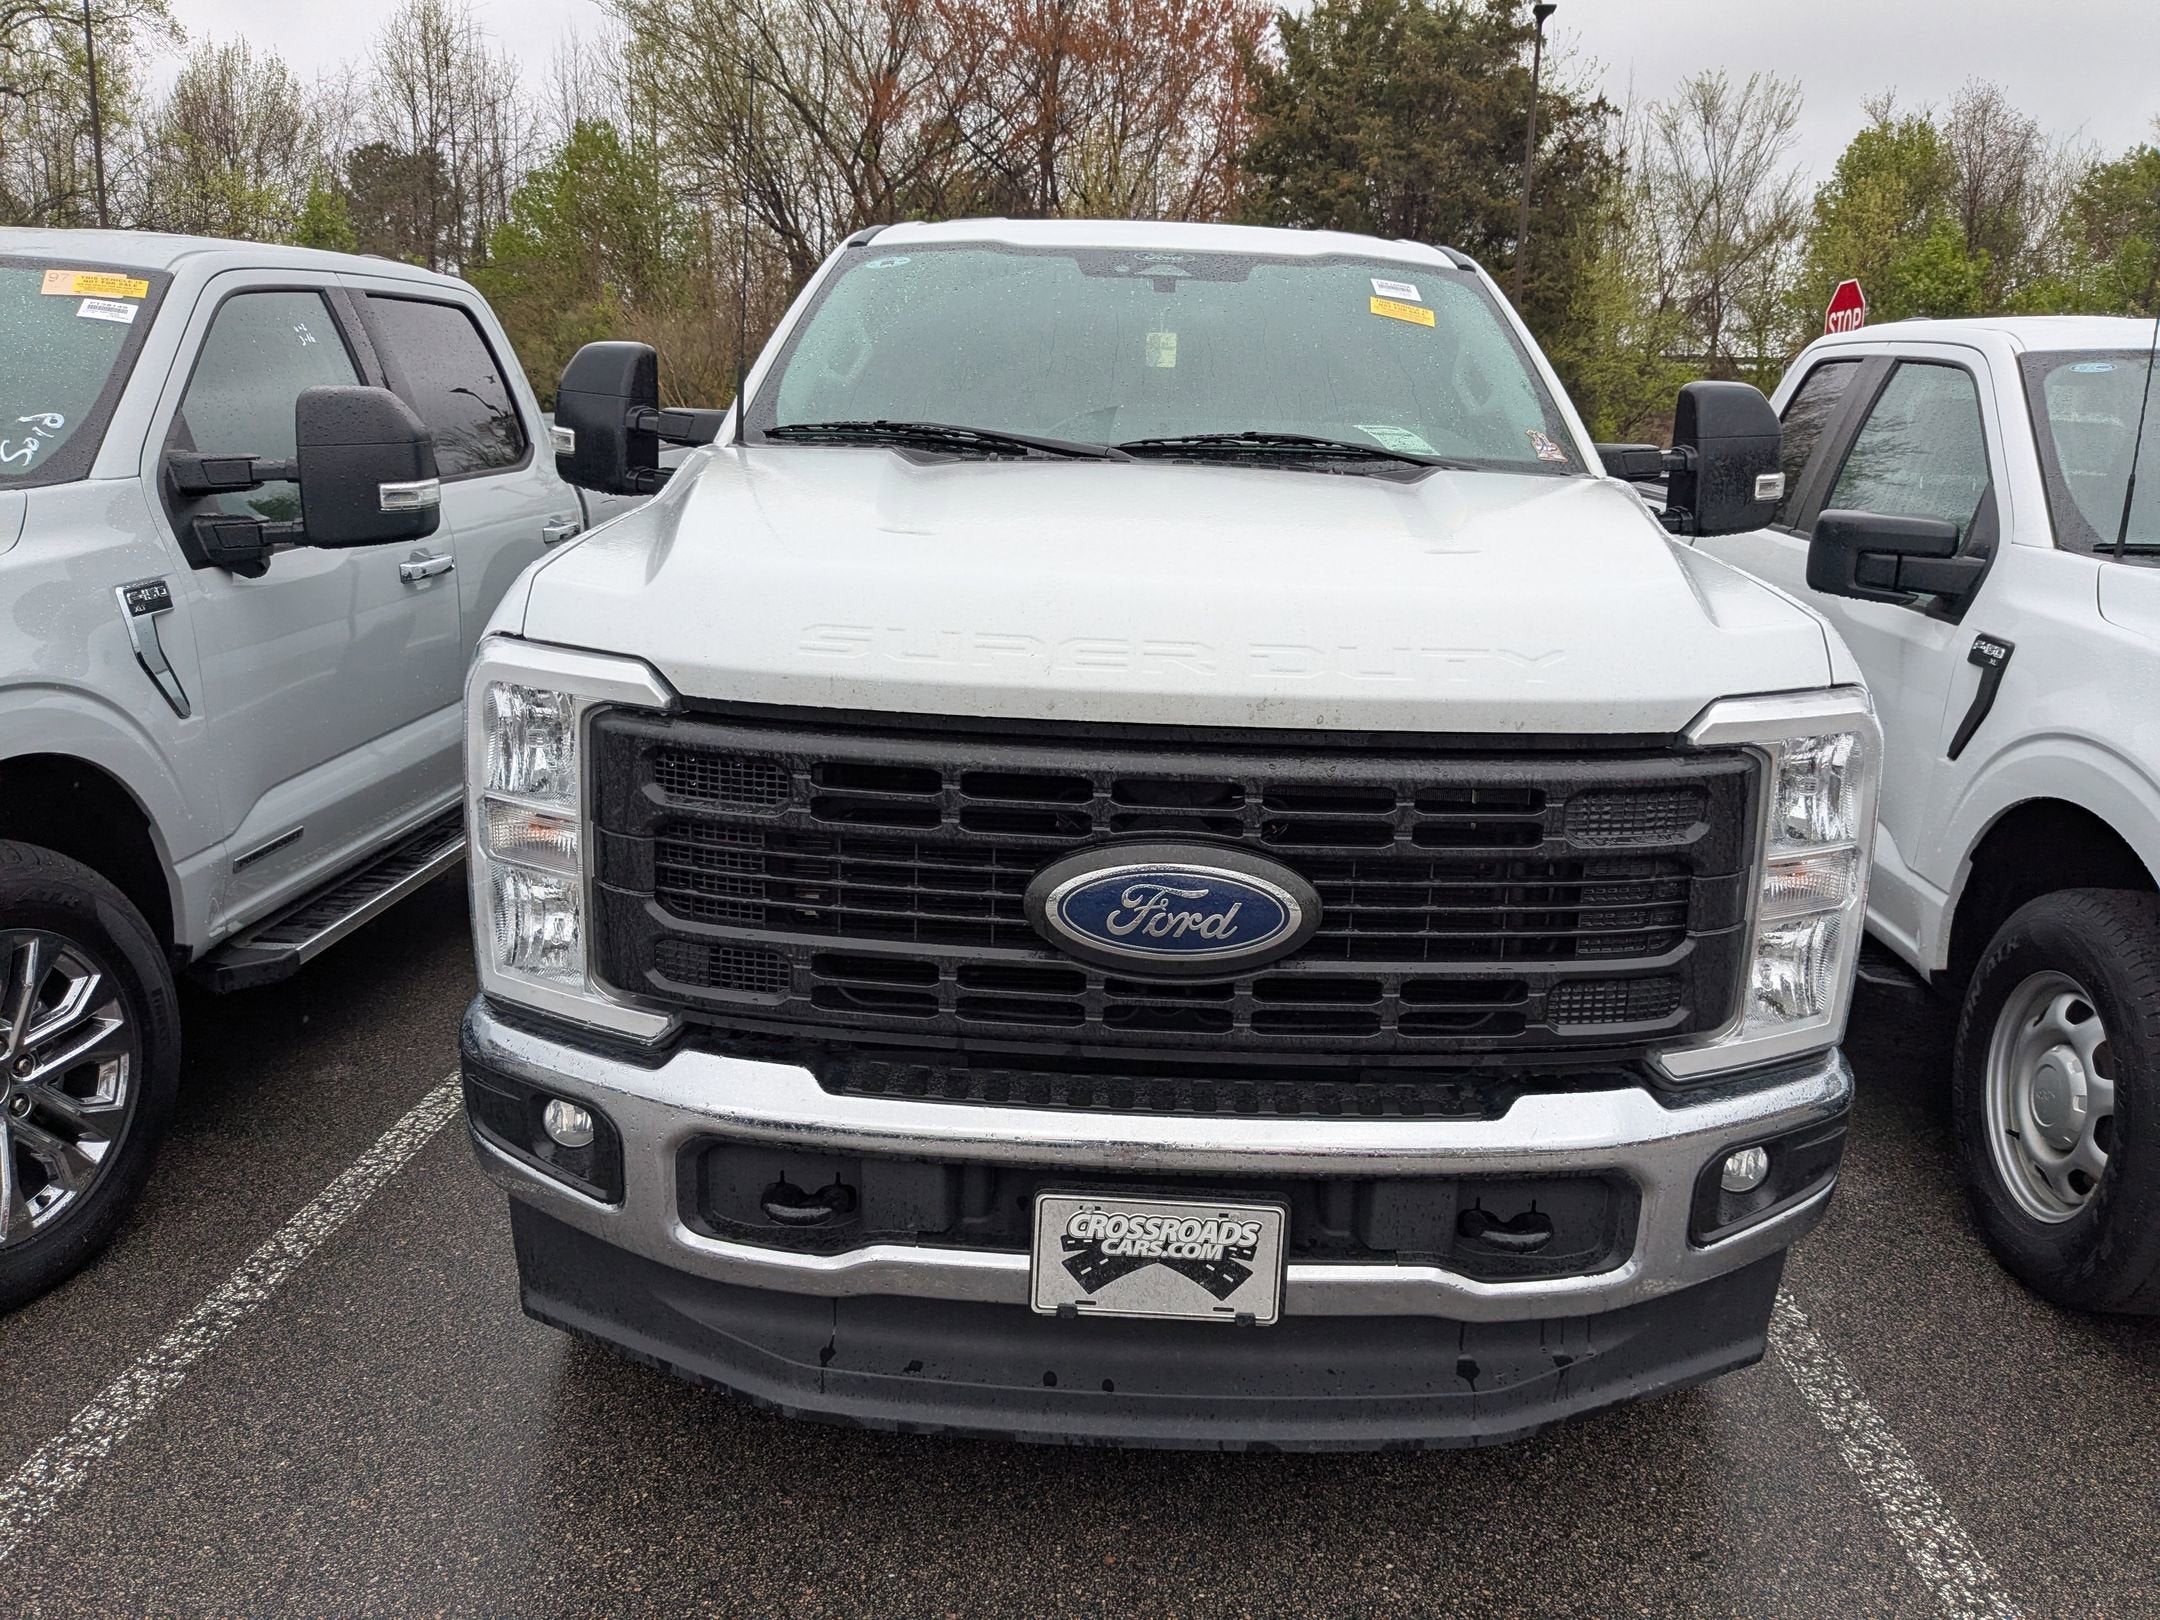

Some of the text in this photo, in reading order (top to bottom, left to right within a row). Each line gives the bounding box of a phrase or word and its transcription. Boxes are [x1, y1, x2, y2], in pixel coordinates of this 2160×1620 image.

[1828, 307, 1862, 333] STOP
[797, 623, 1566, 683] SUPER DUTY
[1106, 883, 1242, 940] Ford
[1066, 1211, 1262, 1248] CROSSROADS
[1100, 1238, 1228, 1262] CARS.COM
